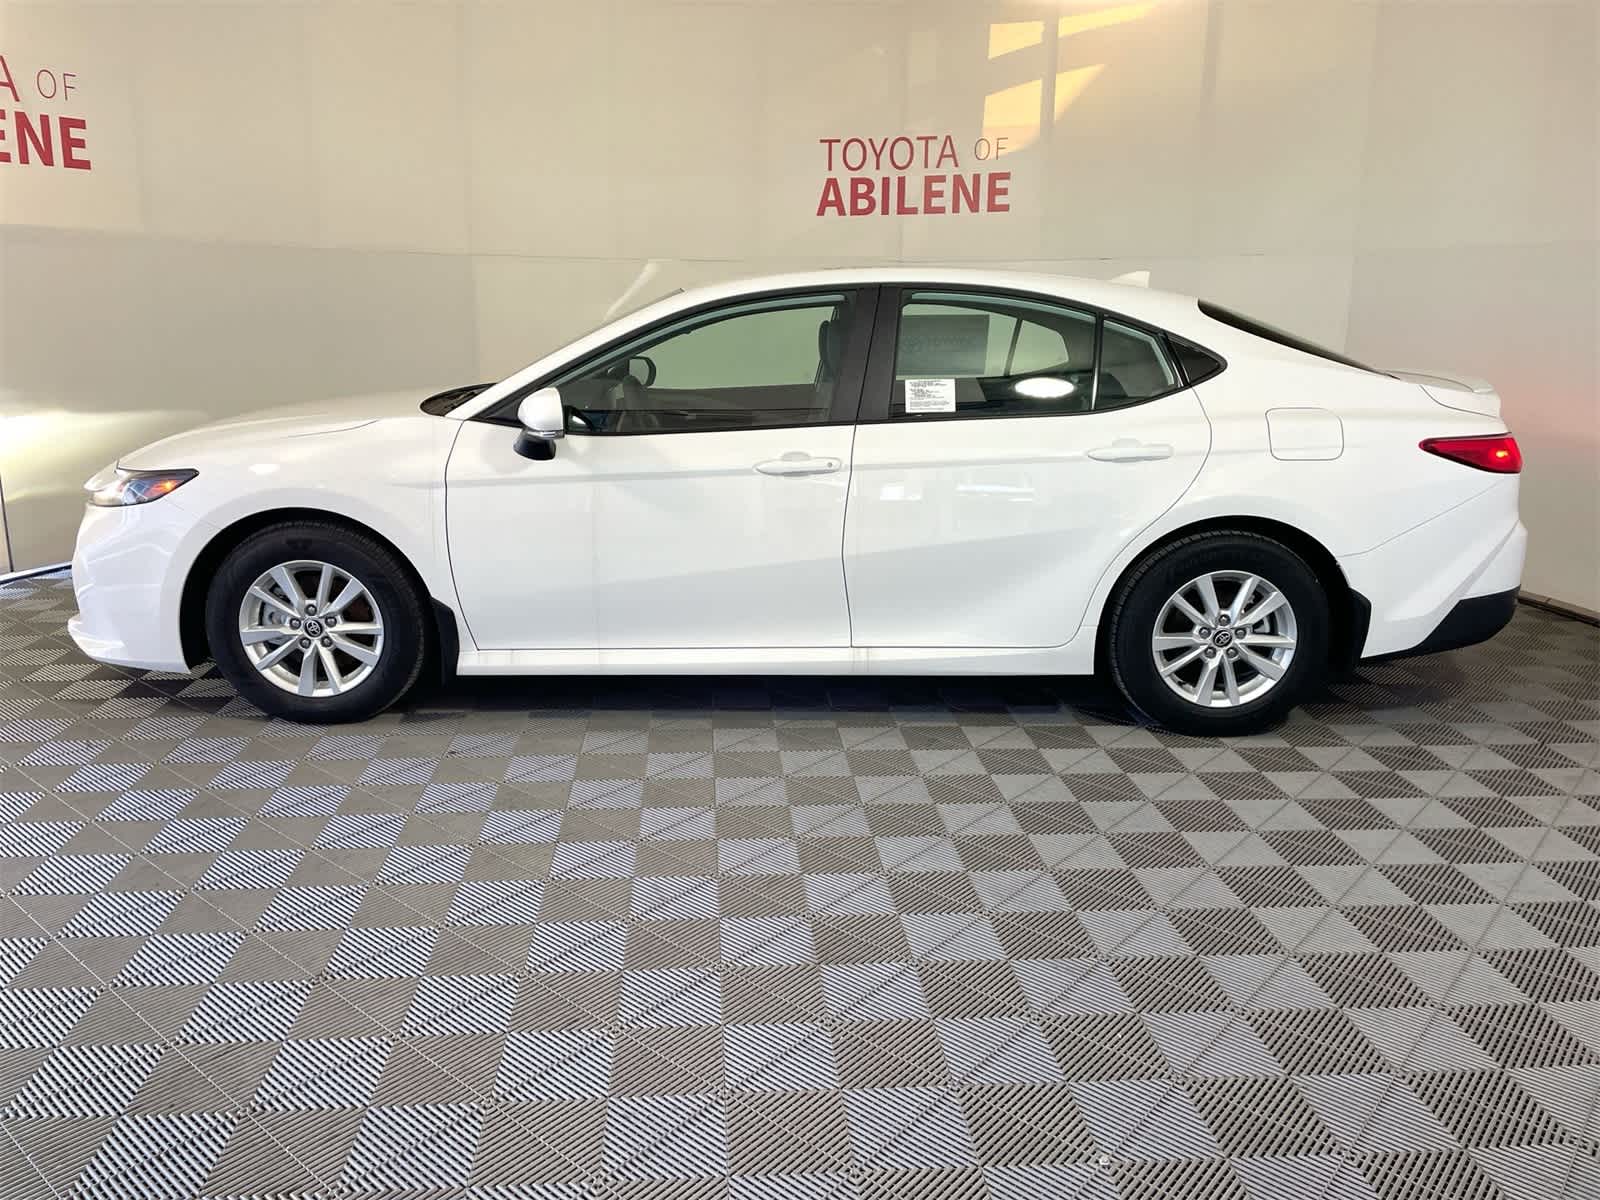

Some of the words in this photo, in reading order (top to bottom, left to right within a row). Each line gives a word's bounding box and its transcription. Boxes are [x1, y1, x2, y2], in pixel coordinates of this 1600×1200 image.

[36, 69, 77, 101] OF
[819, 135, 959, 172] TOYOTA
[974, 137, 1009, 161] OF
[816, 172, 1011, 217] ABILENE
